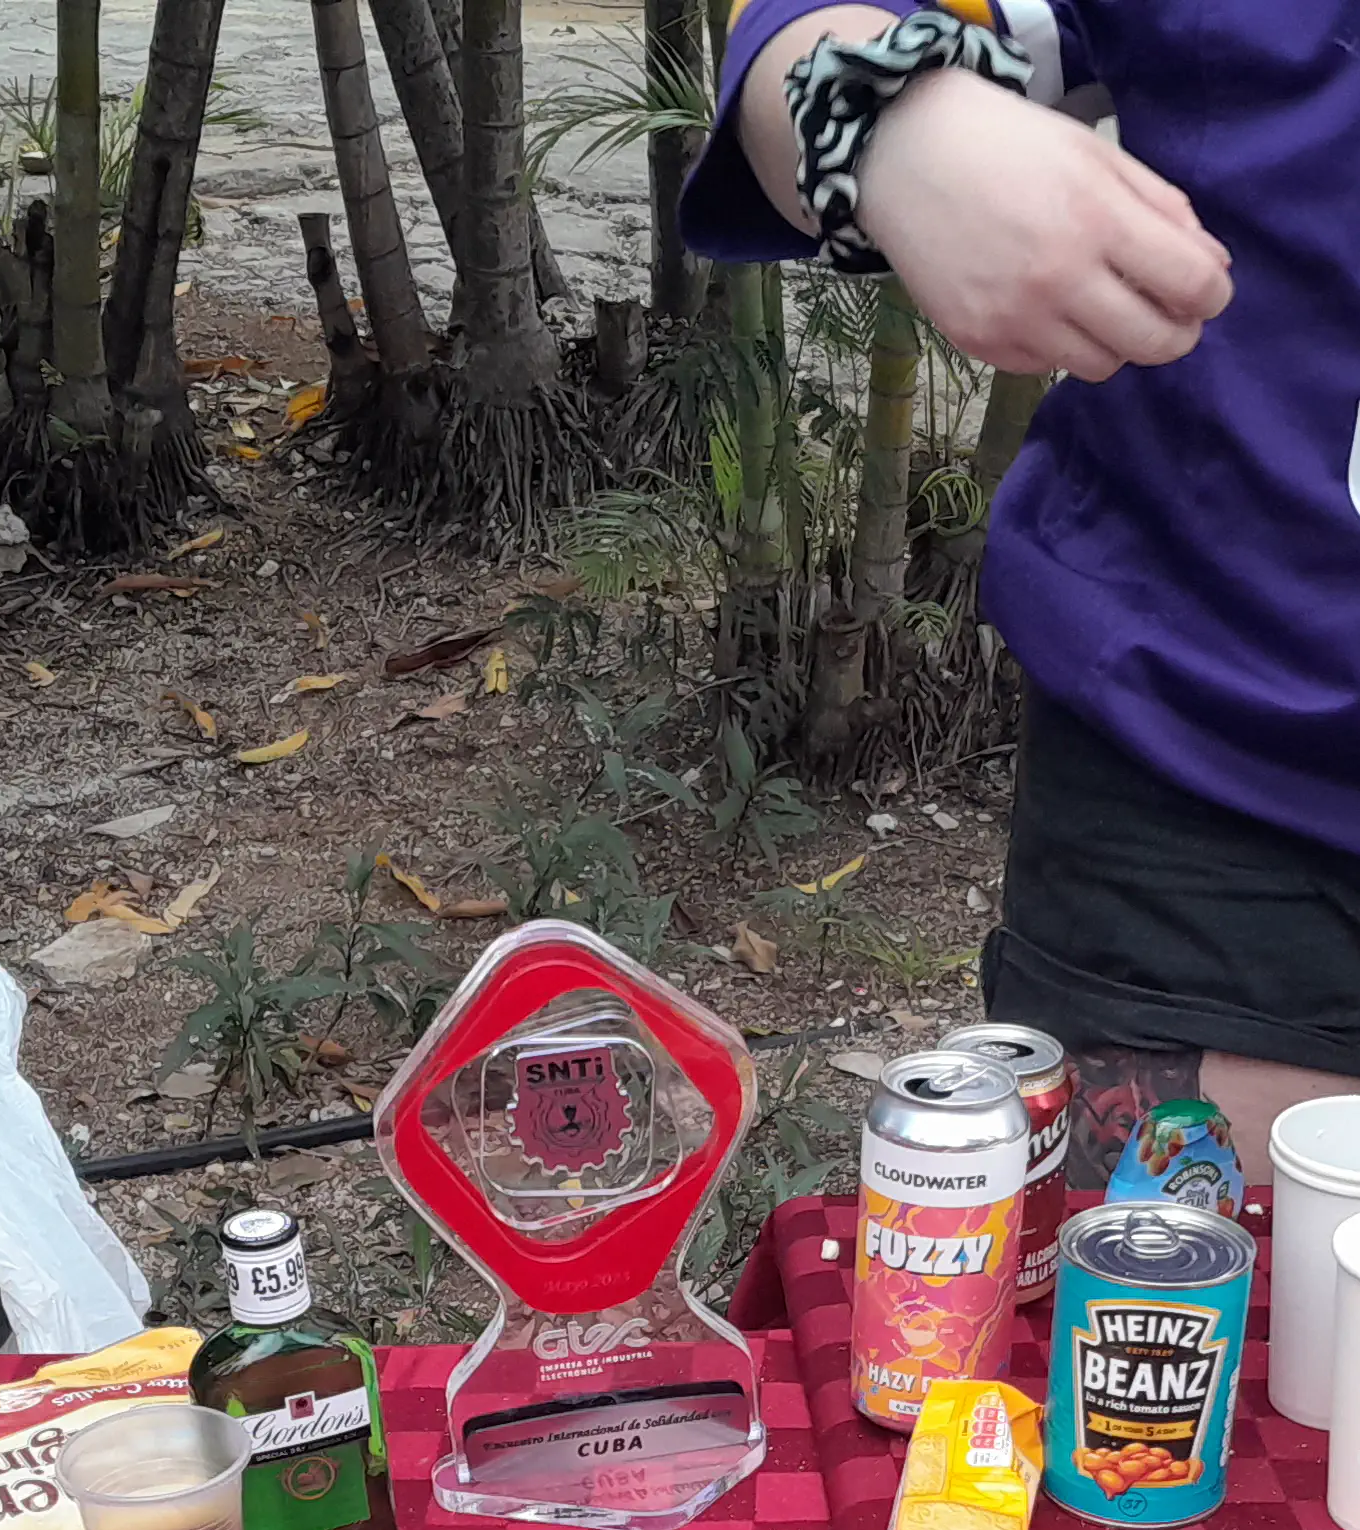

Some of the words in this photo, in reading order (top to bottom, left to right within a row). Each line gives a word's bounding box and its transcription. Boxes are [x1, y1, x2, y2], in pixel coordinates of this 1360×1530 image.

[874, 1161, 988, 1191] CLOUDWATER
[865, 1218, 993, 1277] FUZZY
[251, 1252, 305, 1296] £5.99
[1102, 1314, 1204, 1349] HEINZ
[586, 1358, 599, 1368] DE
[868, 1362, 916, 1393] HAZY
[1083, 1349, 1211, 1401] BEANZ
[1097, 1398, 1104, 1406] a
[1105, 1399, 1128, 1412] rich
[1130, 1403, 1170, 1414] tomato
[1172, 1401, 1201, 1414] sauce
[243, 1401, 367, 1450] Gordon's
[627, 1416, 641, 1431] de
[1104, 1420, 1111, 1432] 1
[1146, 1424, 1155, 1437] 5
[577, 1435, 643, 1458] CUBA
